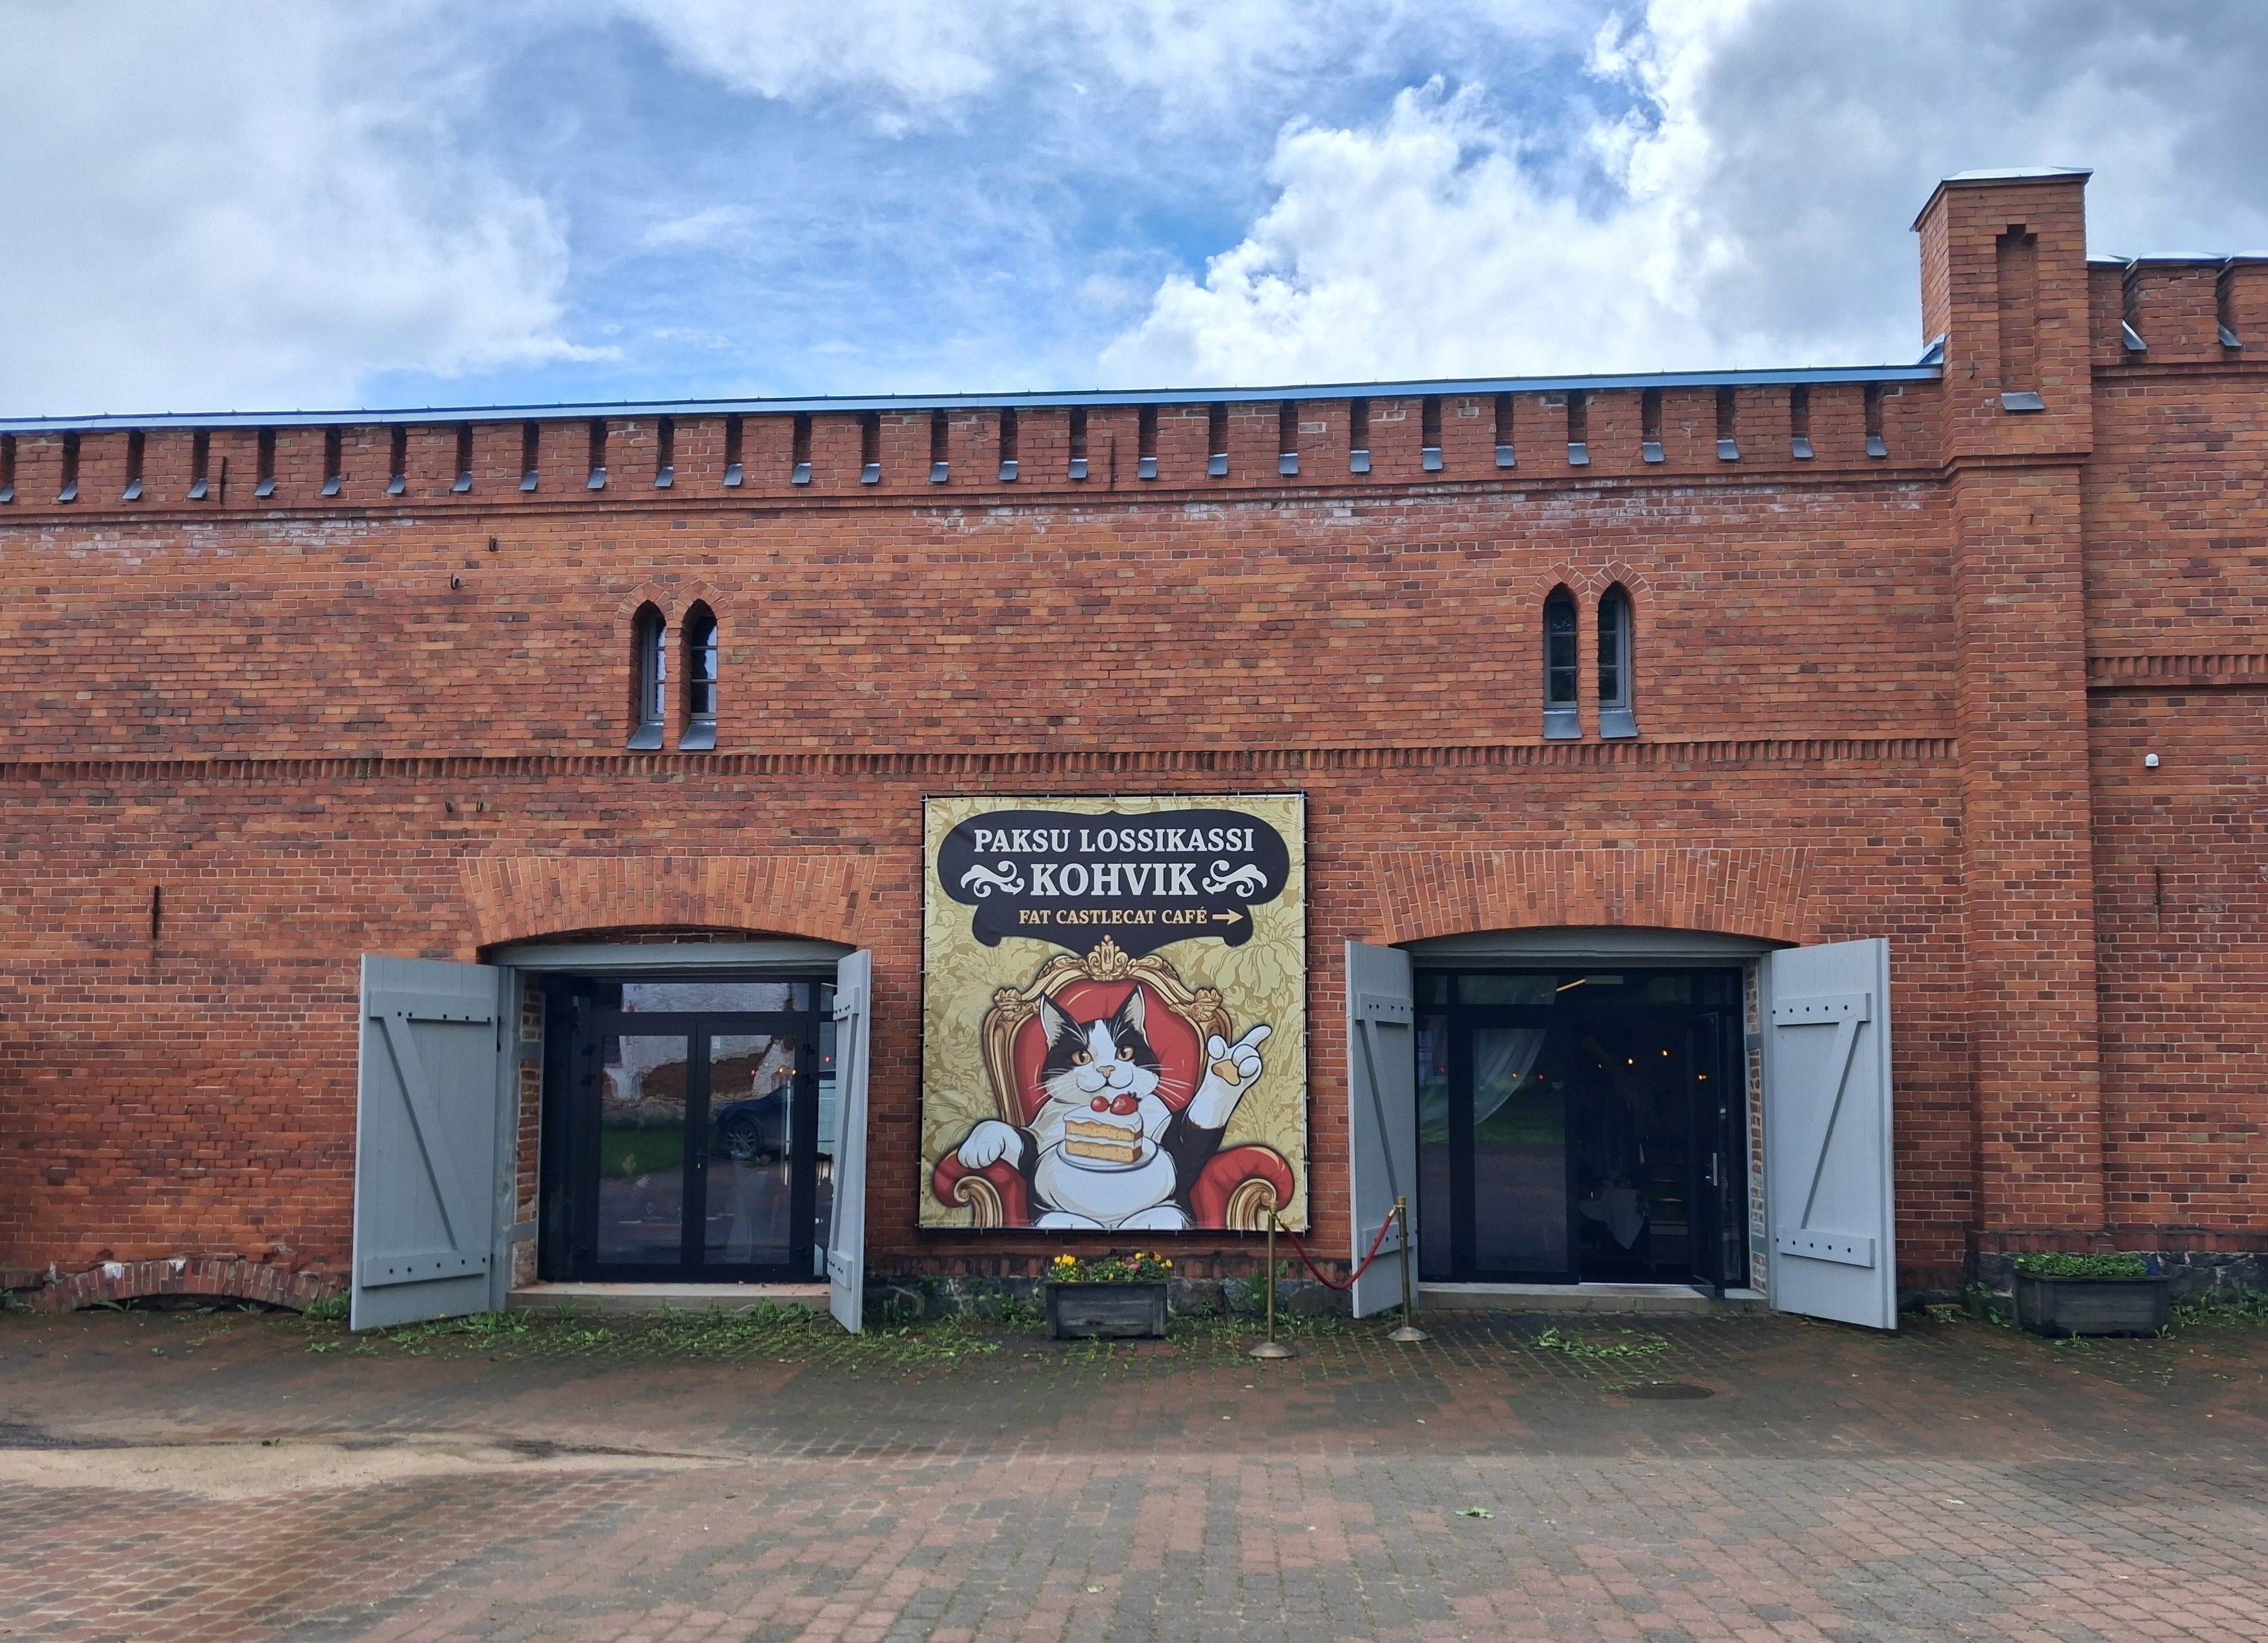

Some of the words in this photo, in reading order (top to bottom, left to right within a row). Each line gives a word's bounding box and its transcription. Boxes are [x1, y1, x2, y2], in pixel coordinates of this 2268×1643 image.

[974, 829, 1071, 853] PAKSU
[1079, 828, 1254, 852] LOSSIKASSI
[1030, 863, 1198, 896] KOHVIK
[1019, 909, 1051, 924] FAT
[1056, 909, 1156, 924] CASTLECAT
[1161, 906, 1207, 924] CAFÉ
